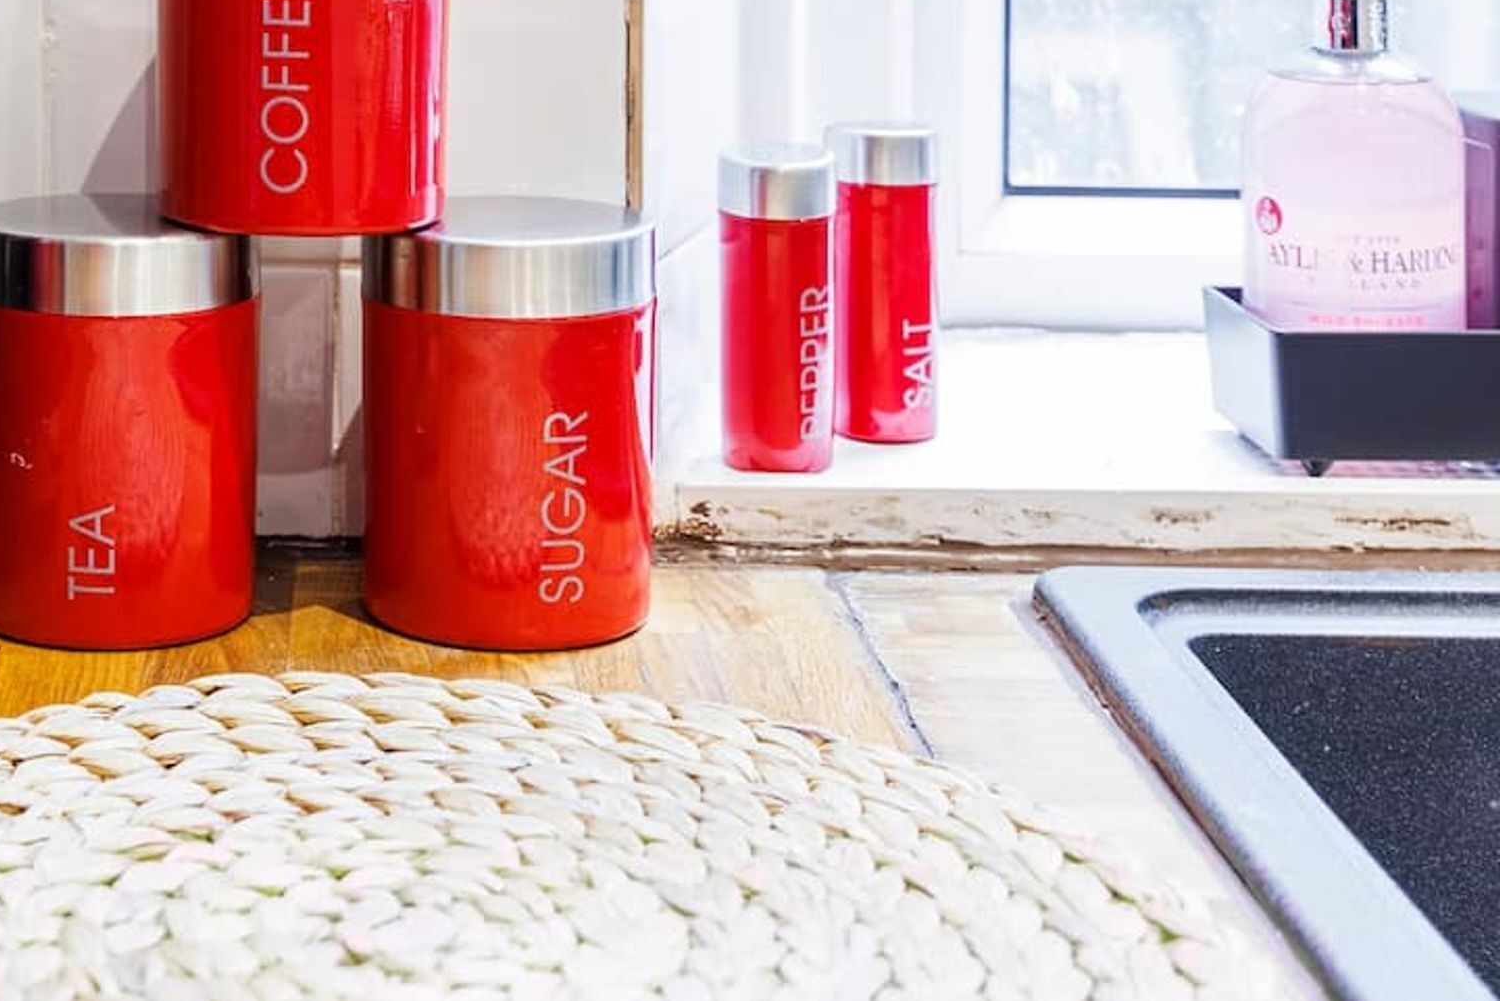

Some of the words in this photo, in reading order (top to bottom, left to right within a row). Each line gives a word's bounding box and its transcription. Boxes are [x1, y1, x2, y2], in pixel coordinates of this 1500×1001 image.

[800, 284, 831, 440] PEPPER
[902, 318, 934, 409] SALT
[67, 504, 116, 601] TEA
[538, 411, 589, 604] SUGAR
